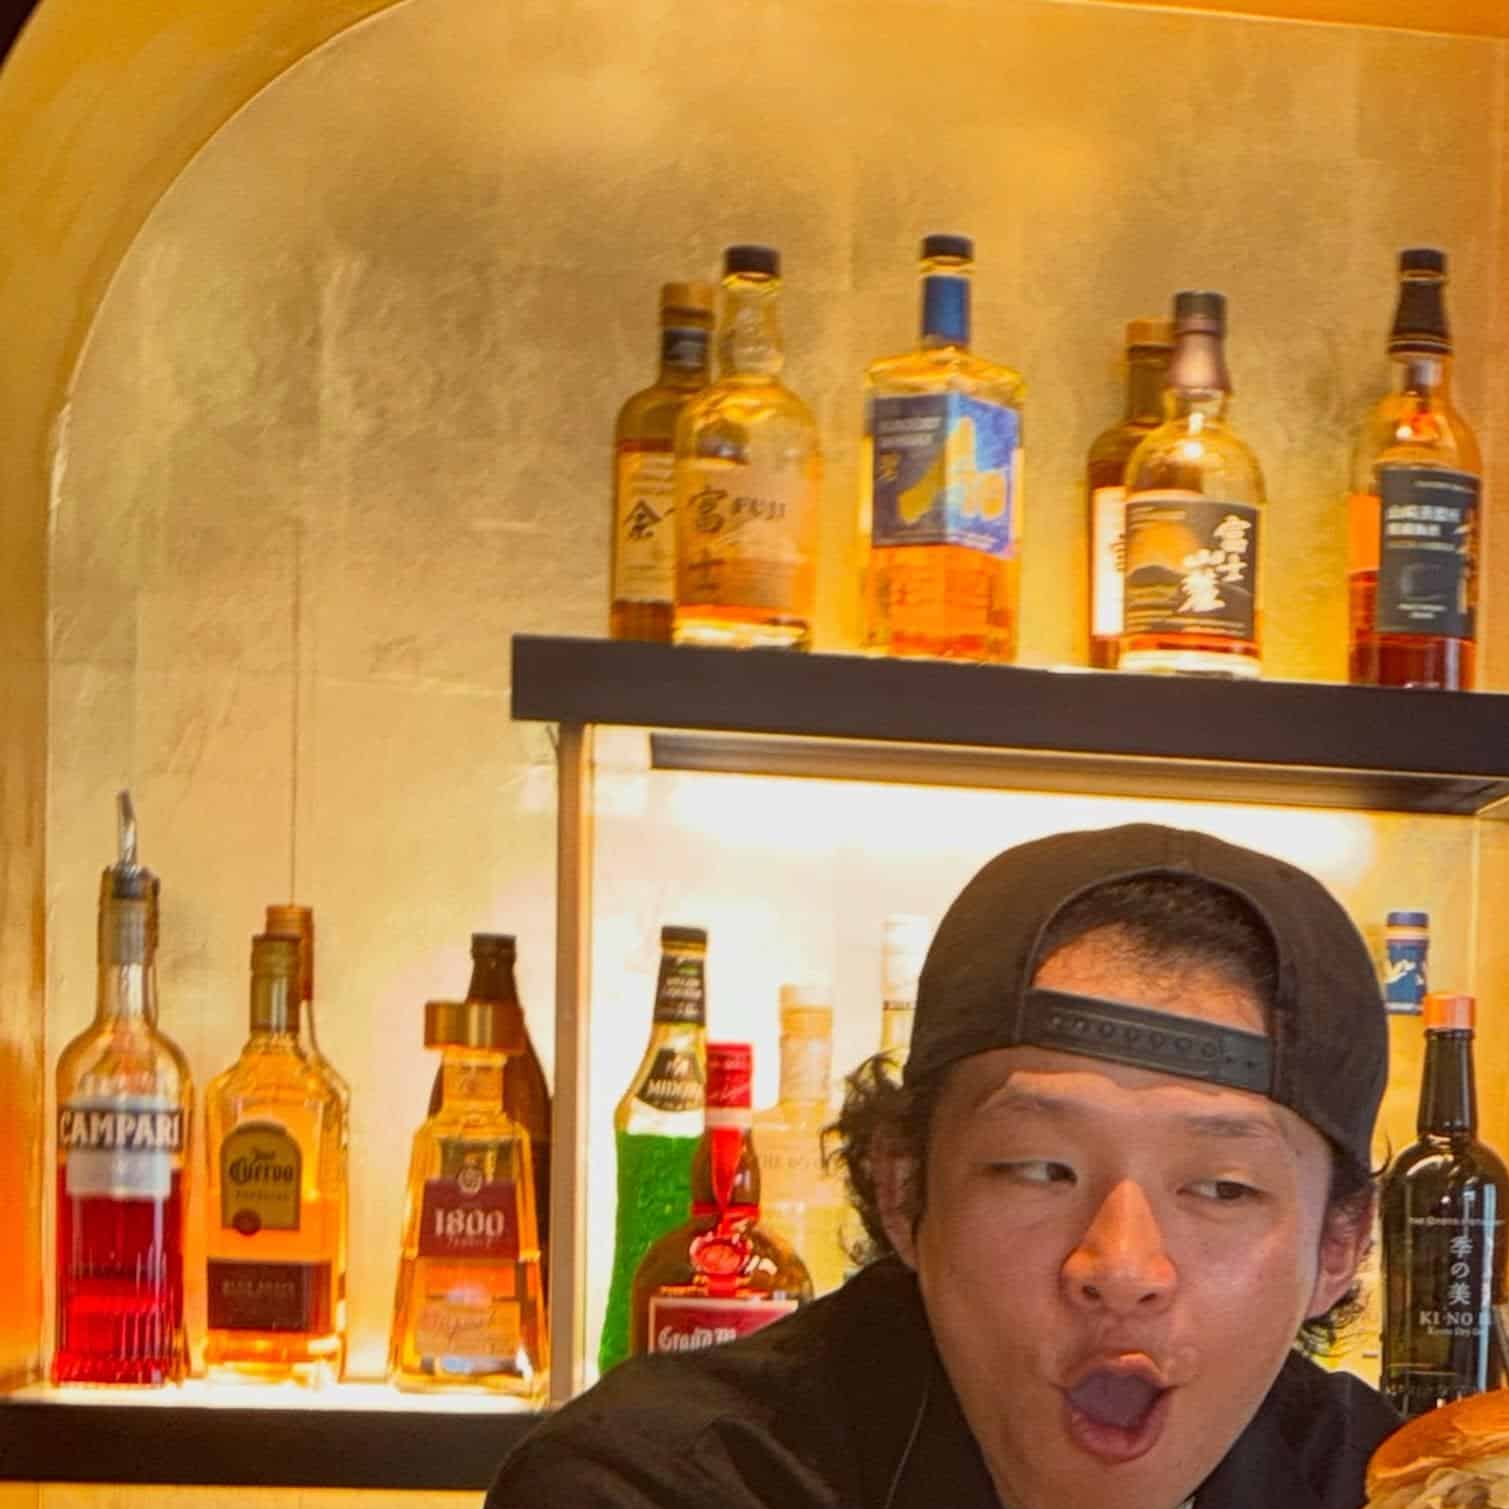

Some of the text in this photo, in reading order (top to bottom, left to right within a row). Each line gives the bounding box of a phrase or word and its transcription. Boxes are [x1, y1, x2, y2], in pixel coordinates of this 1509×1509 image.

[58, 1110, 181, 1146] CAMPARI
[434, 1208, 505, 1238] 1800
[1449, 1235, 1473, 1306] 季の美
